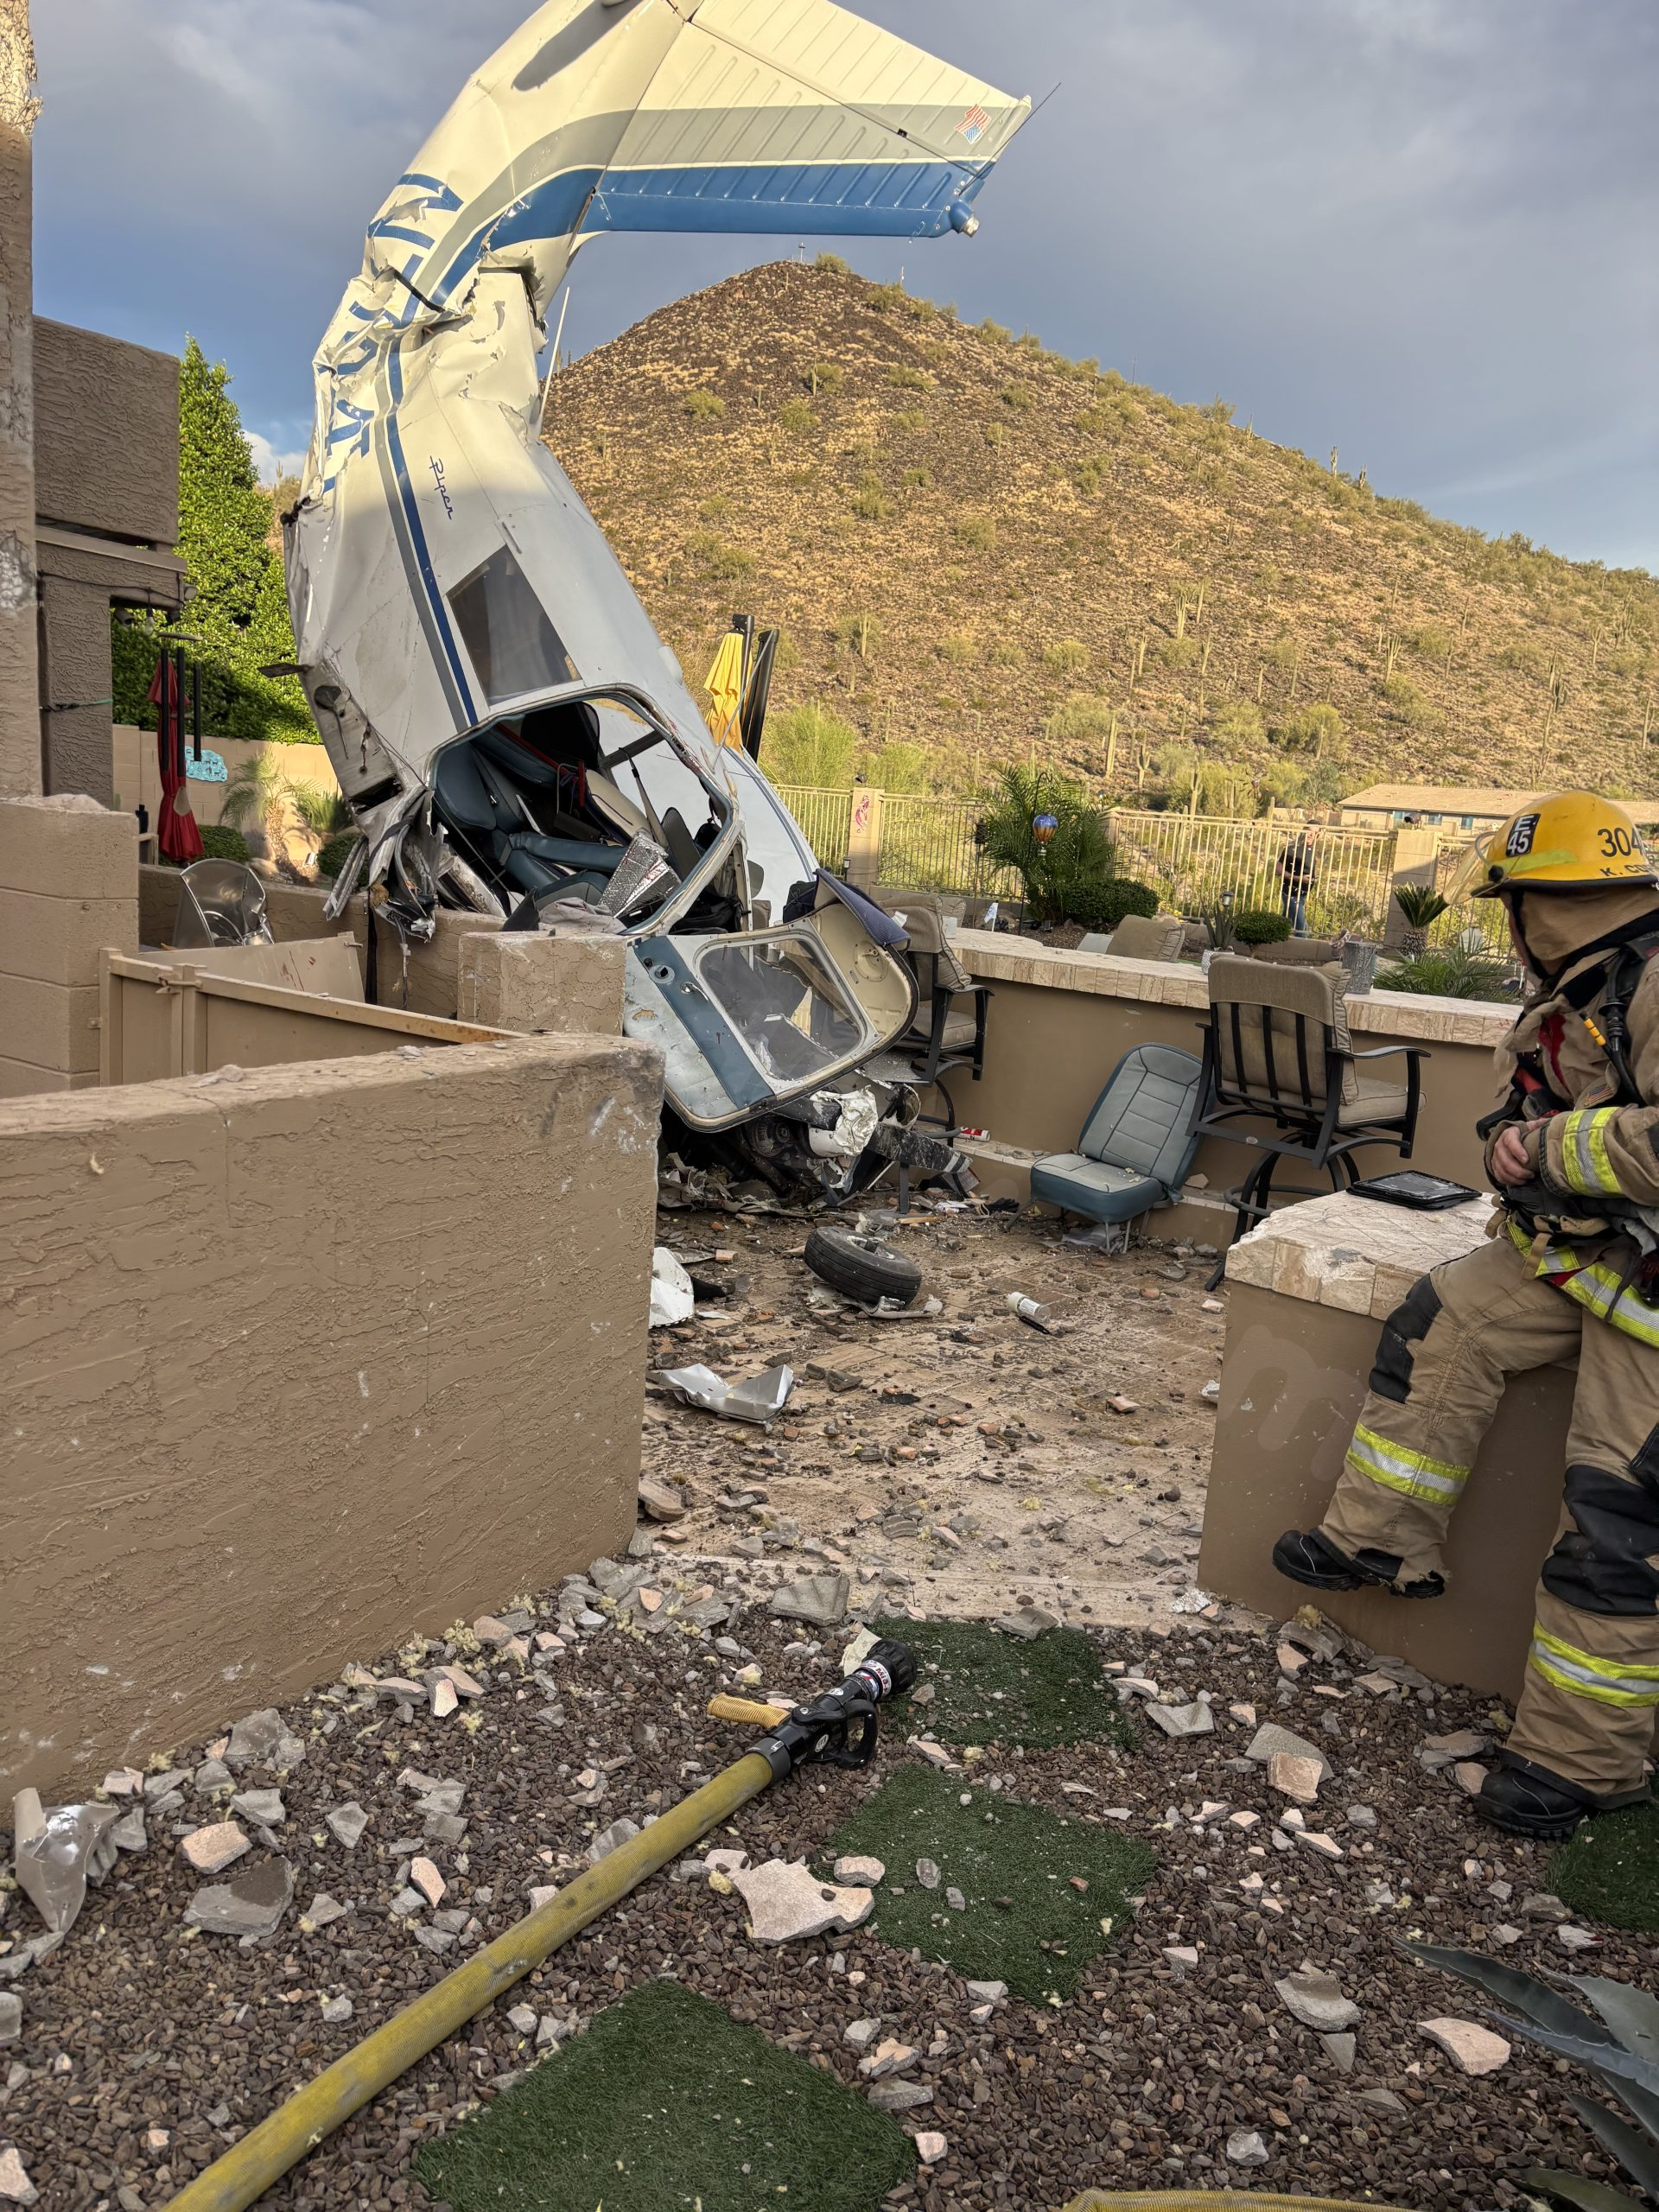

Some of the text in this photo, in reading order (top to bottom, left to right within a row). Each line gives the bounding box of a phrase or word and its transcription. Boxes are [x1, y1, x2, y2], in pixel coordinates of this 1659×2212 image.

[429, 454, 454, 520] Piper
[1507, 830, 1531, 855] 45
[1597, 827, 1643, 857] 304
